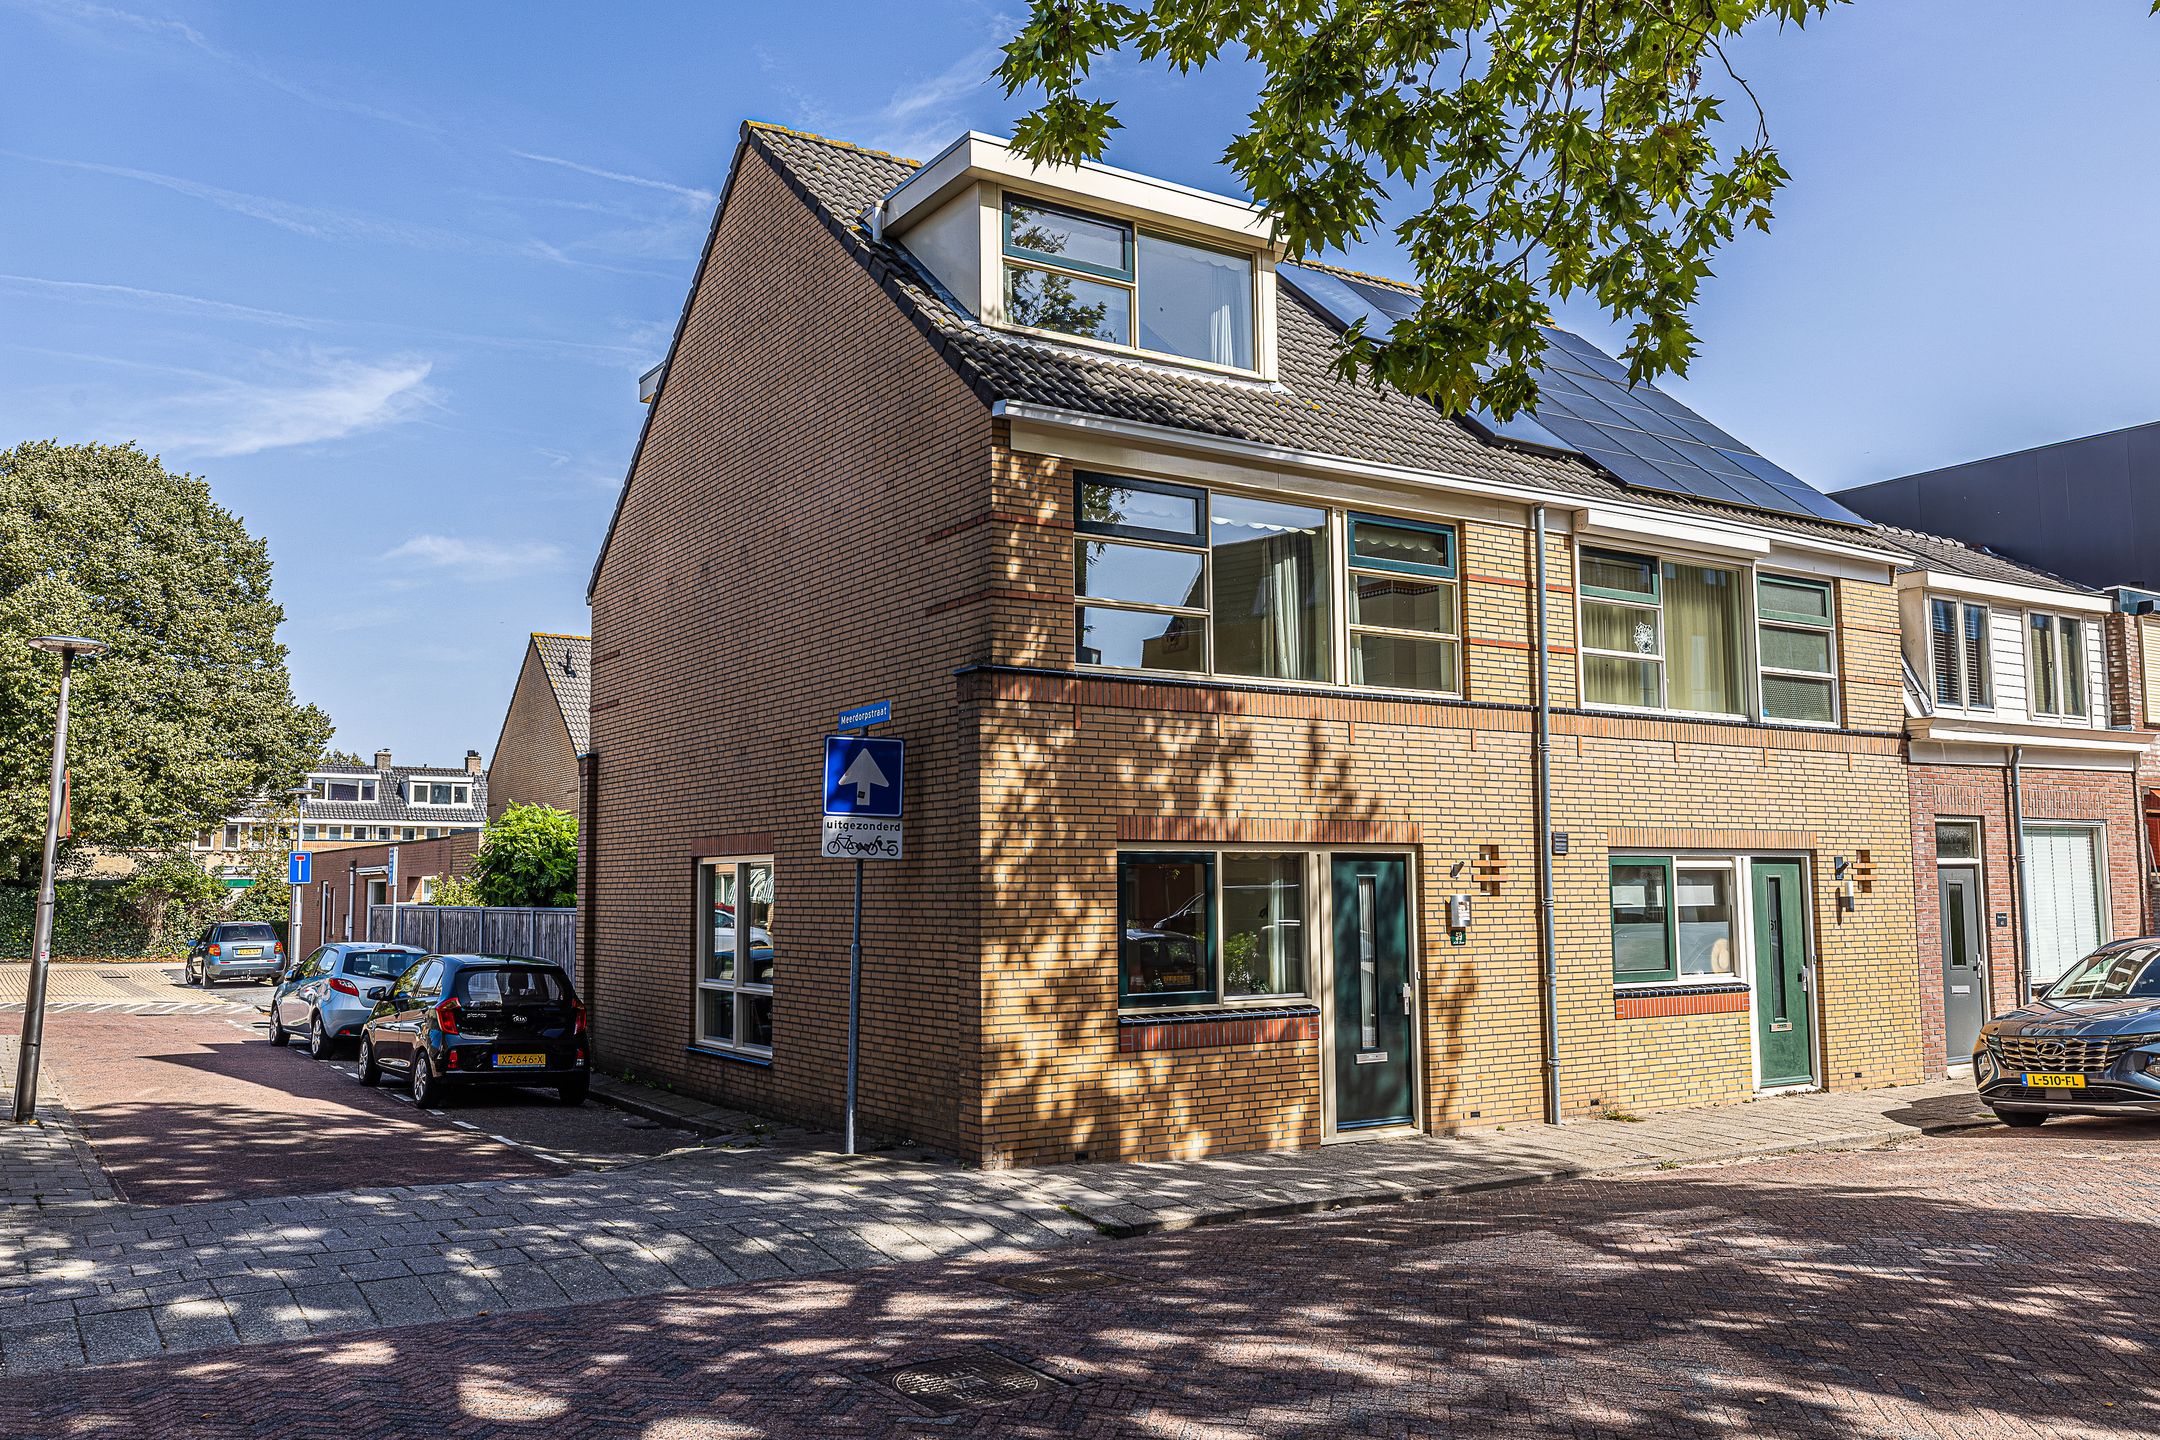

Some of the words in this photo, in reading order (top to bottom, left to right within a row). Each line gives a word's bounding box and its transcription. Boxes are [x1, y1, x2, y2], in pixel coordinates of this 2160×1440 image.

[841, 706, 887, 724] Meerdorpstraat
[826, 820, 901, 832] uitgezonderd
[501, 1055, 543, 1064] XZ-646-X
[2032, 1075, 2079, 1086] L-510-FL
